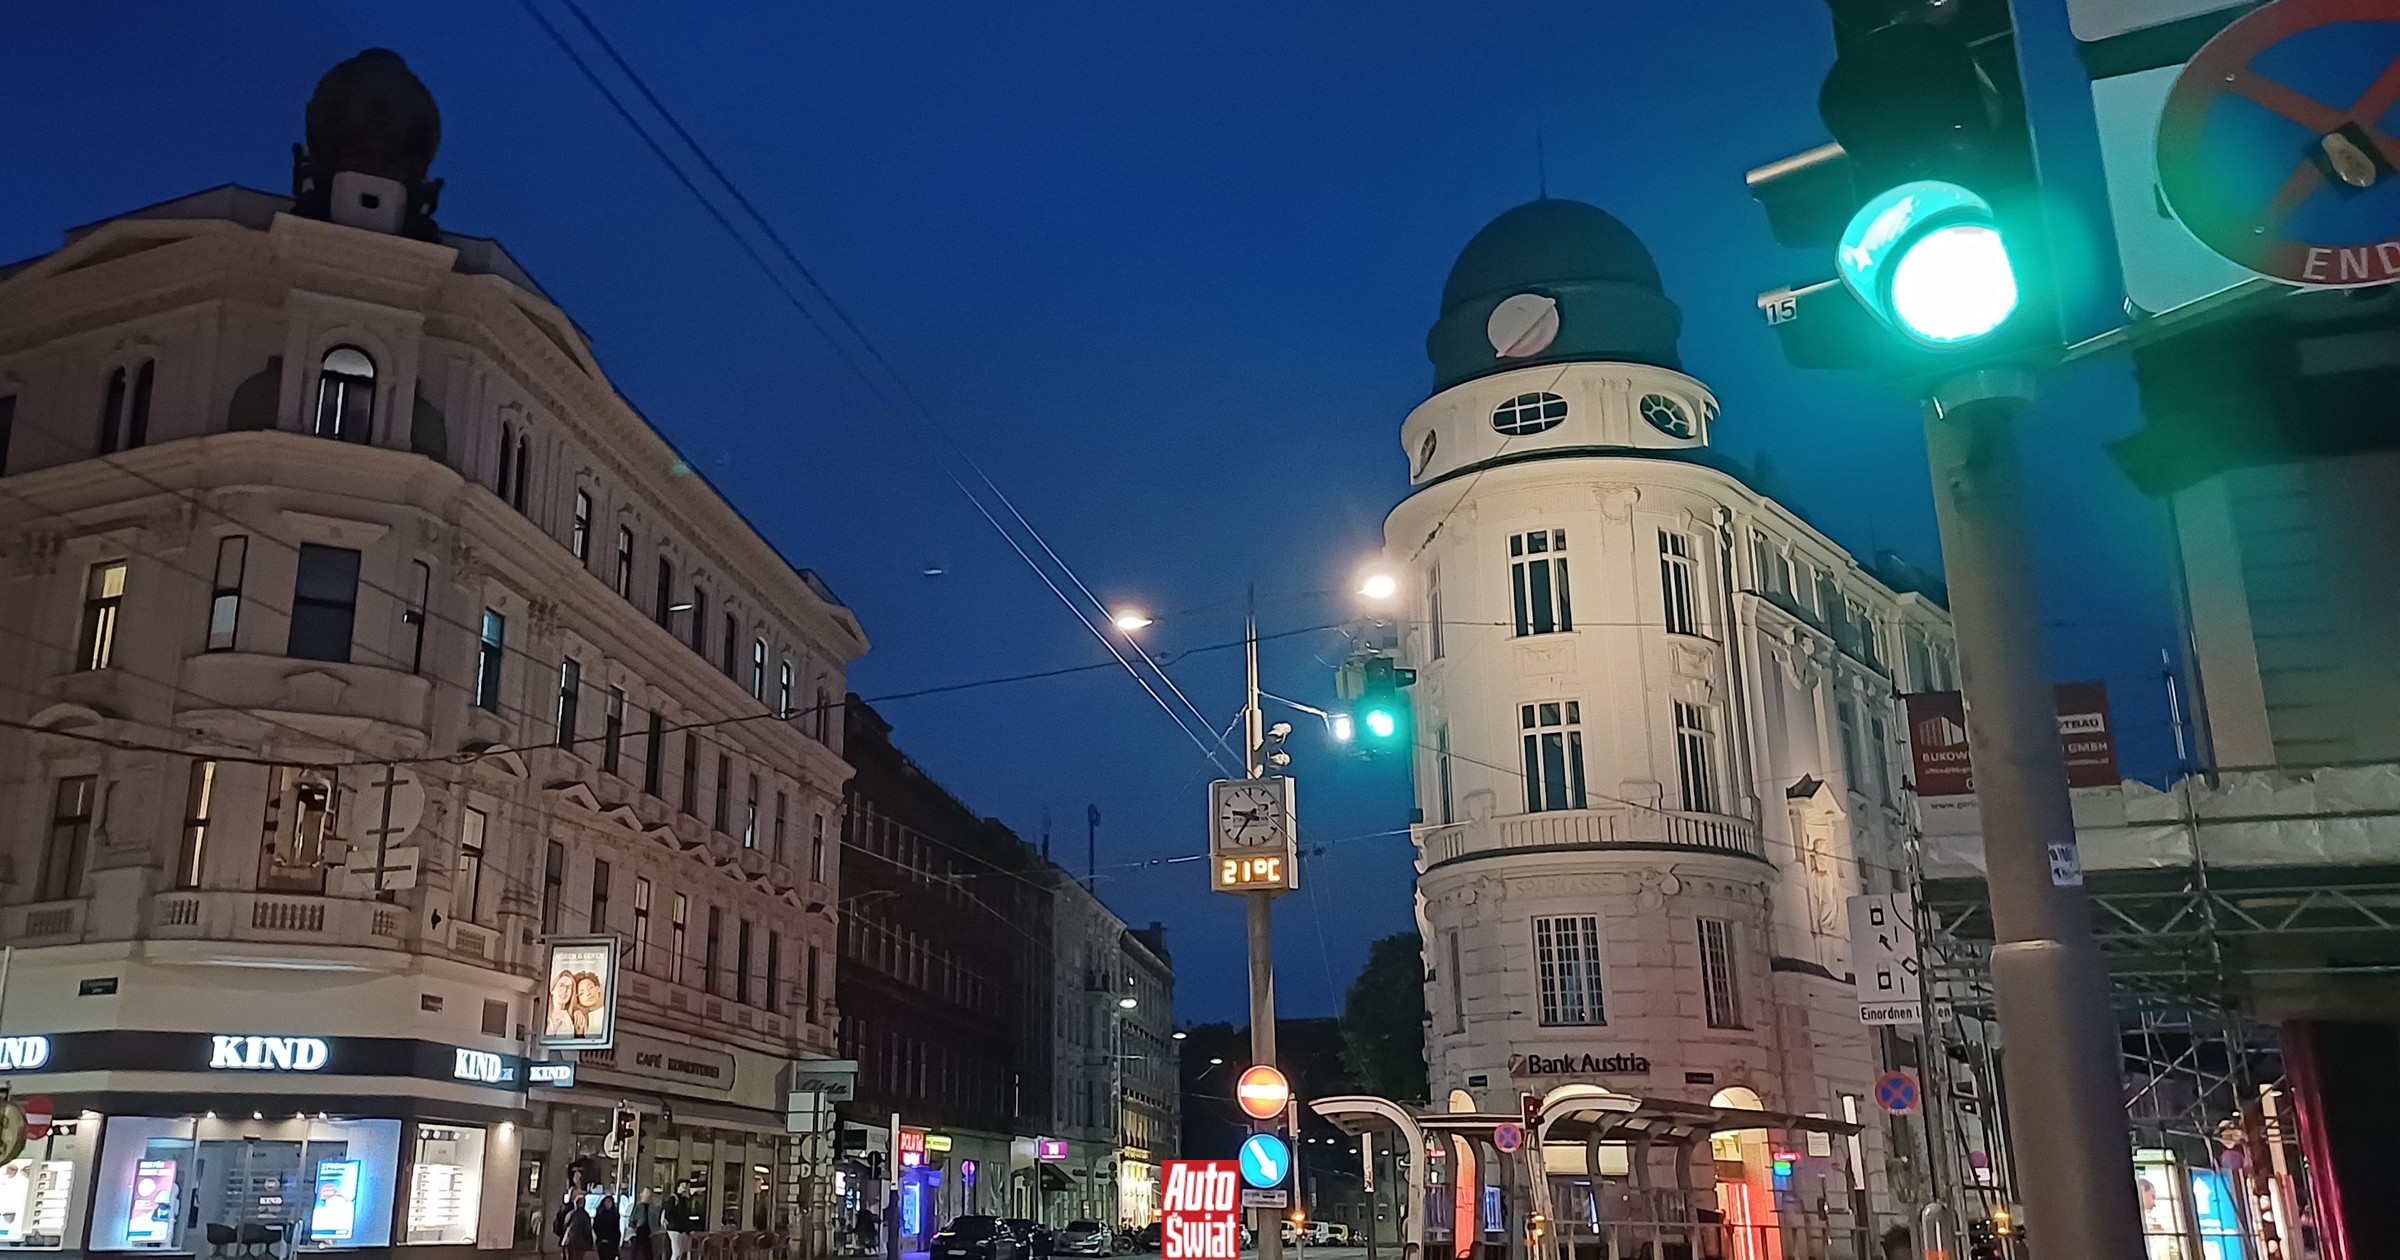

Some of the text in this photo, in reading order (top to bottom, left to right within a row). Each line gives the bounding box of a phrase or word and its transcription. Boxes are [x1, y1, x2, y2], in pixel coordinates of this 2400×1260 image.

[1768, 299, 1795, 323] 15
[2062, 718, 2099, 729] TBAU
[1922, 751, 1968, 762] BUKOW
[1222, 857, 1281, 885] 21°C
[1861, 1006, 1913, 1020] Einordnen
[210, 1036, 329, 1070] KIND
[637, 1052, 662, 1068] CAFÉ
[454, 1048, 502, 1083] KIND
[1528, 1052, 1647, 1074] Bank Austria
[529, 1066, 572, 1081] KIND
